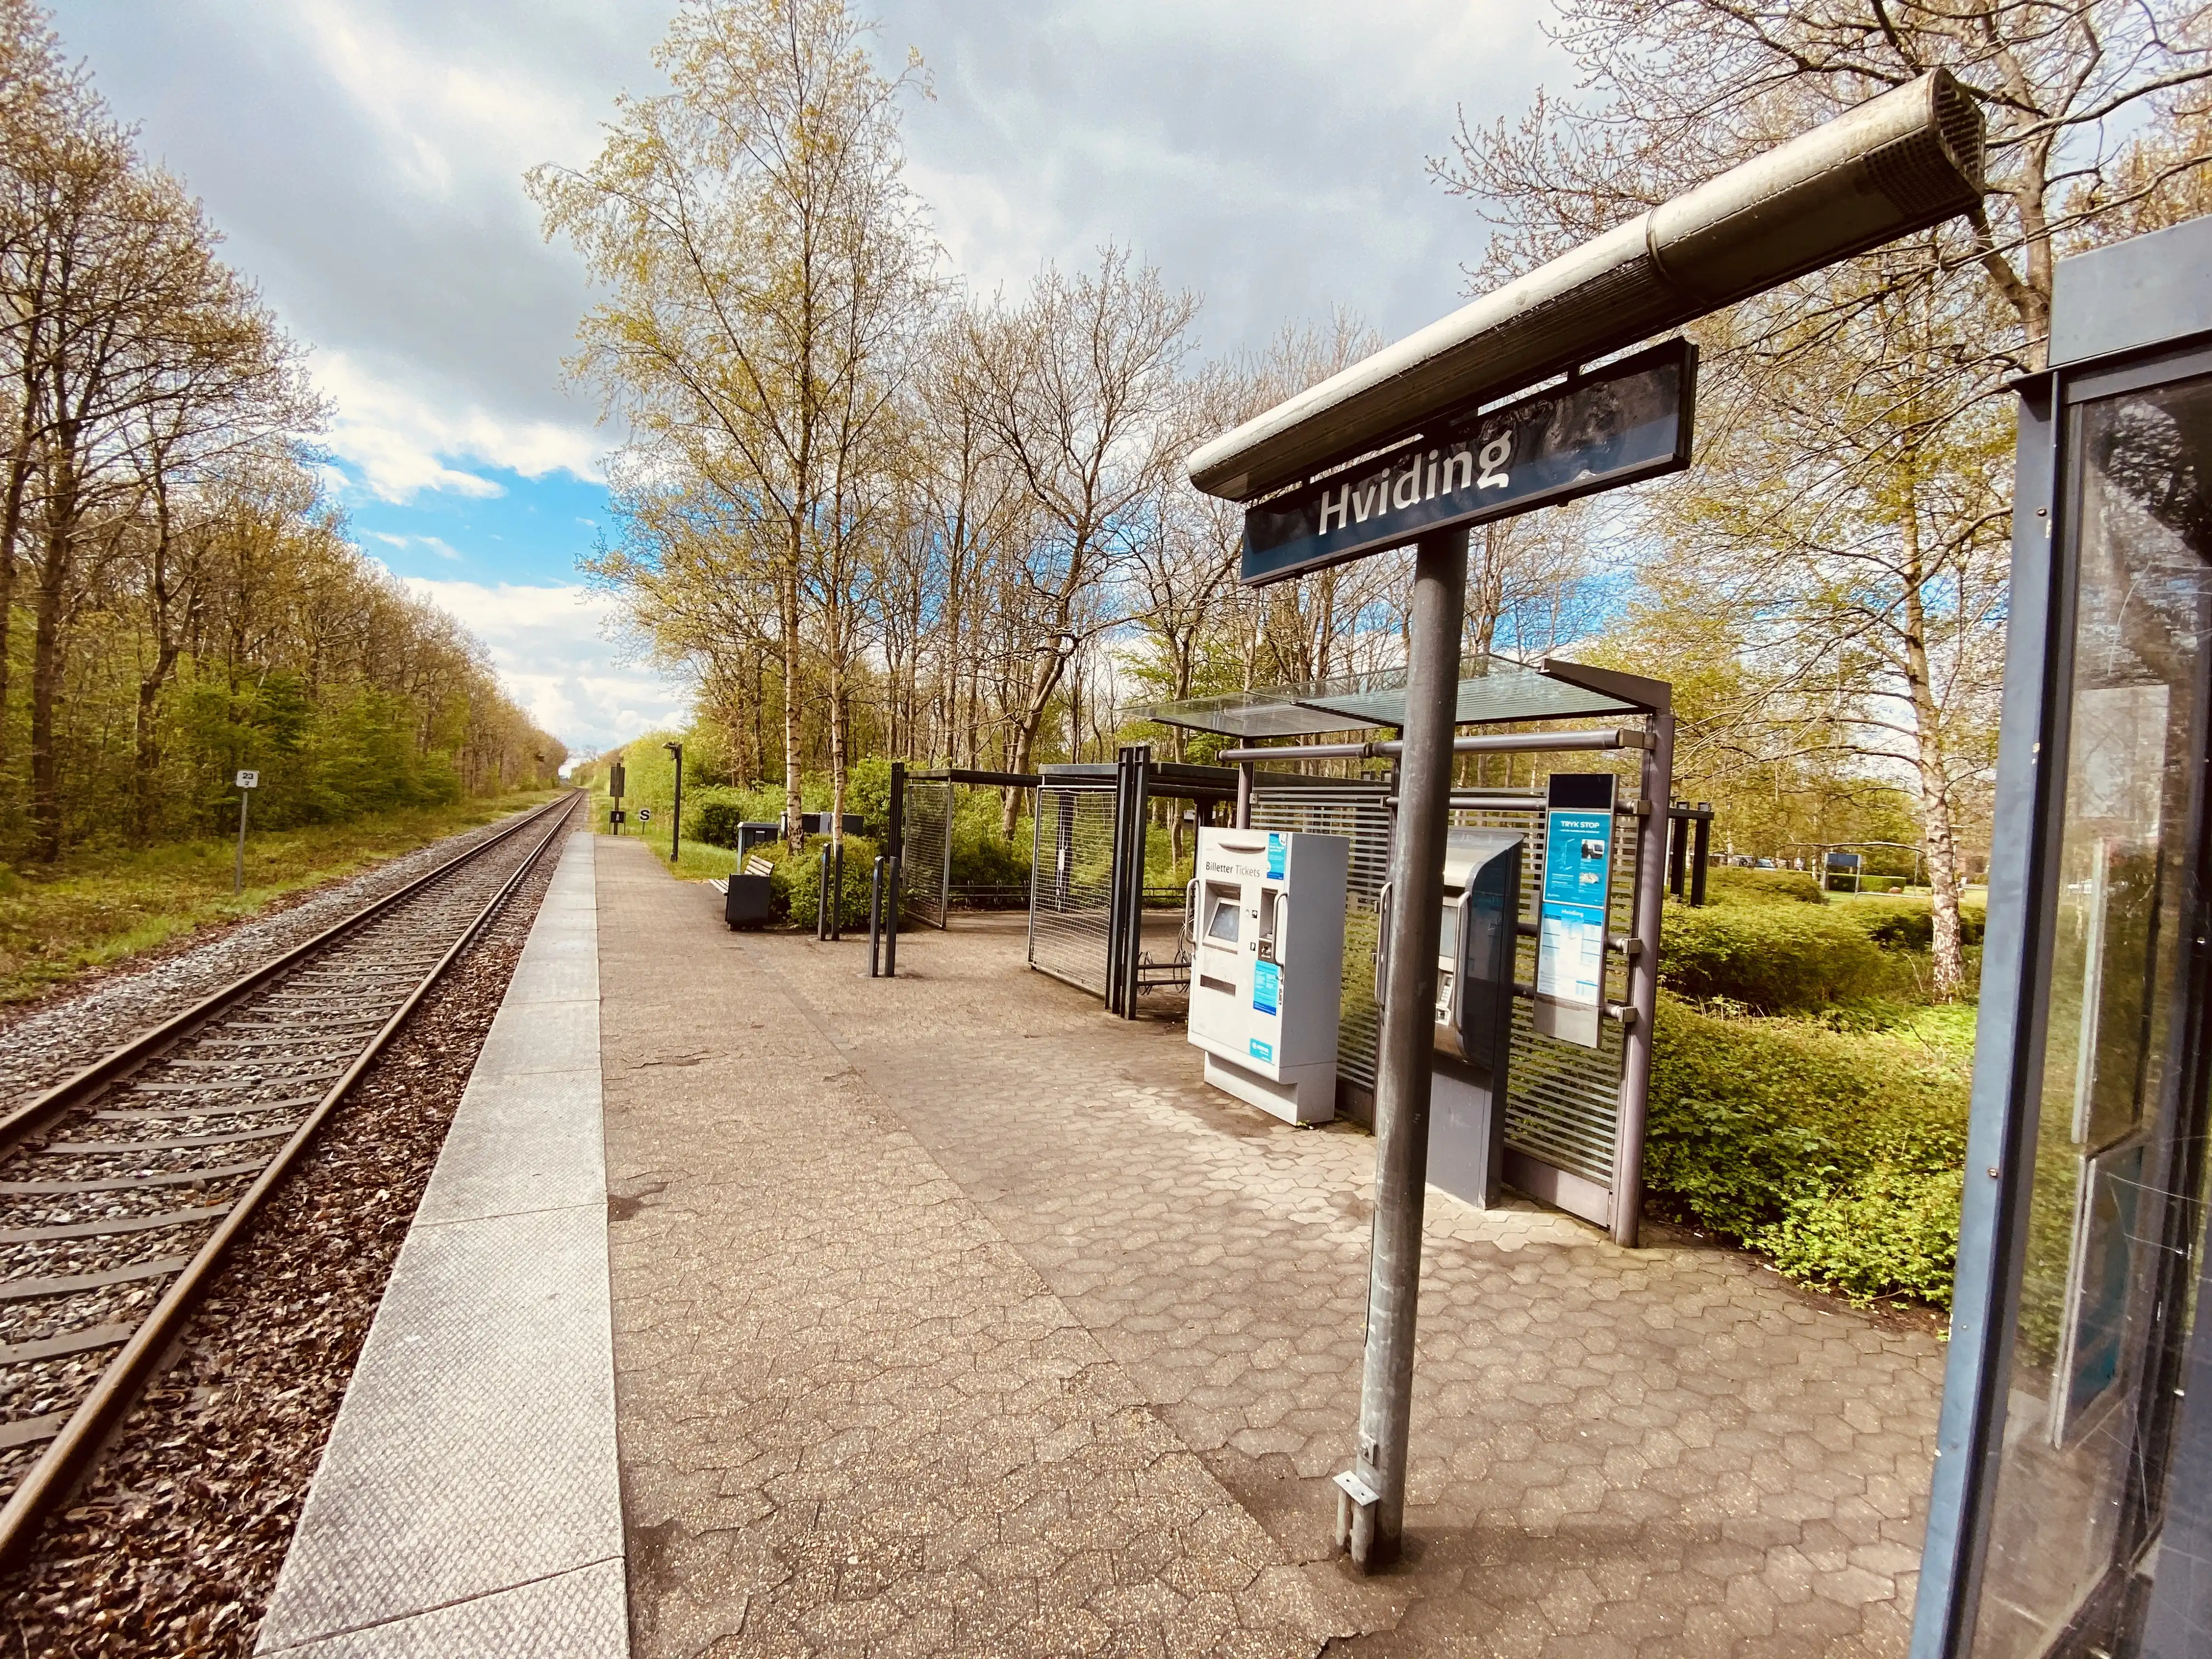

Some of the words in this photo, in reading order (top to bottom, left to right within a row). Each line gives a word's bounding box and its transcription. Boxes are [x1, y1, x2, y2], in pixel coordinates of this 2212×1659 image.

[1319, 430, 1512, 535] Hviding
[640, 810, 650, 820] S
[1206, 861, 1233, 873] Billetter
[1235, 865, 1260, 877] Tickets
[1561, 909, 1584, 917] Hviding
